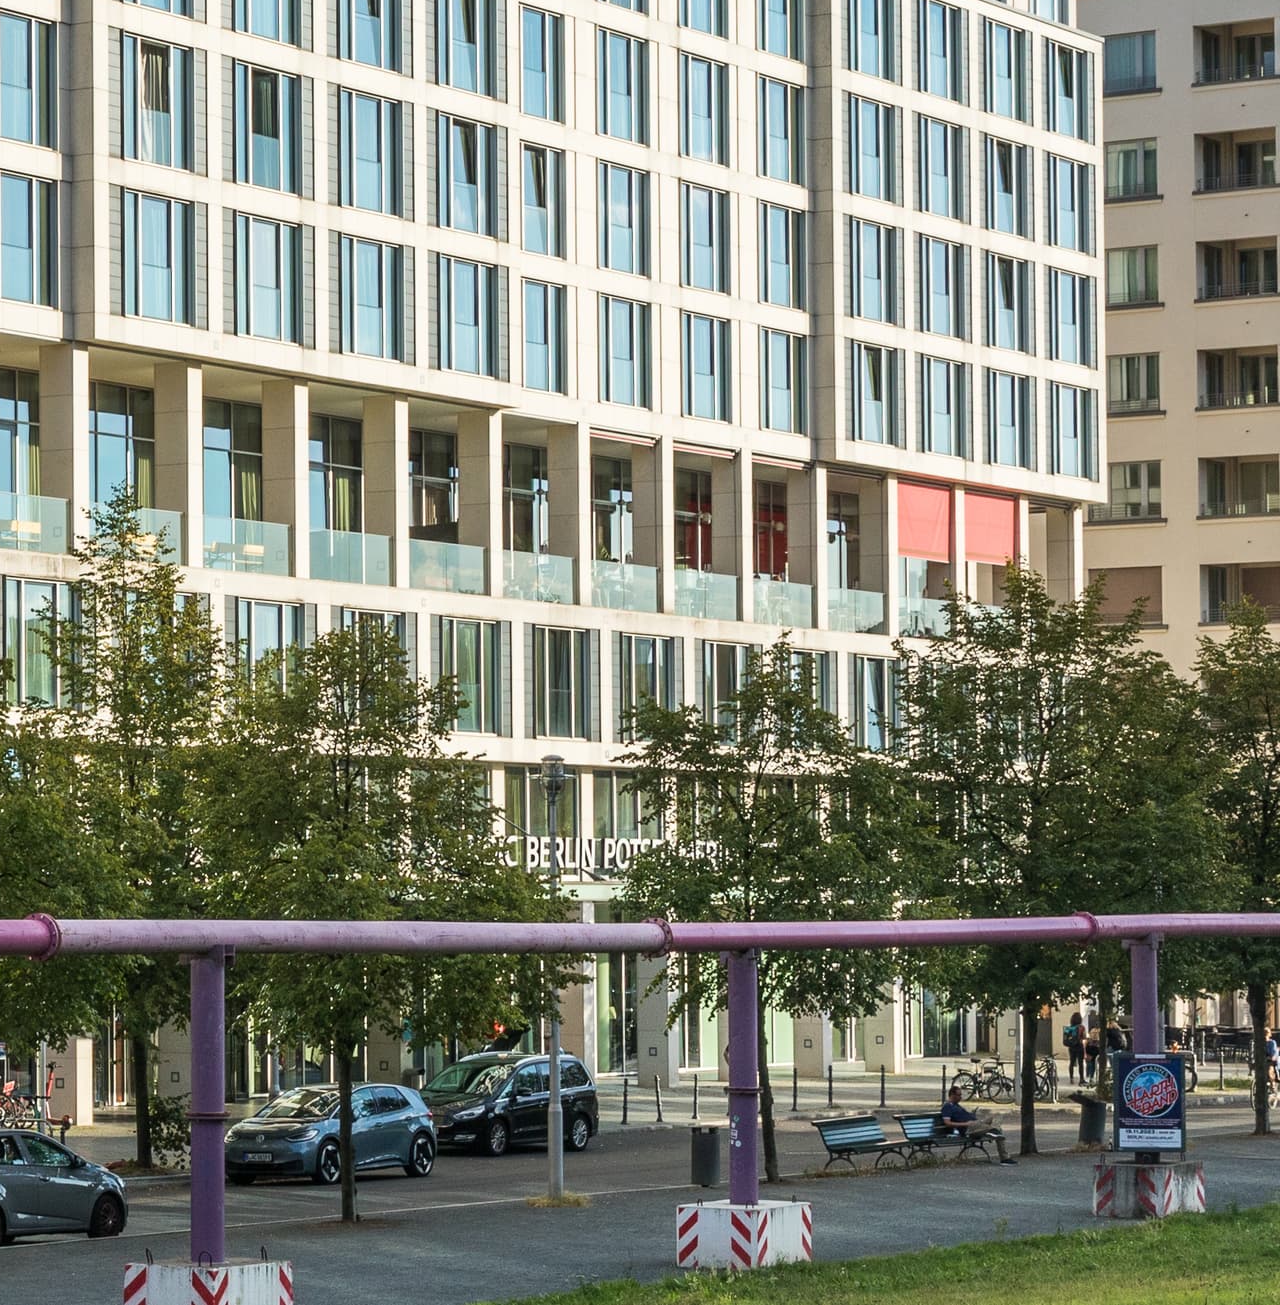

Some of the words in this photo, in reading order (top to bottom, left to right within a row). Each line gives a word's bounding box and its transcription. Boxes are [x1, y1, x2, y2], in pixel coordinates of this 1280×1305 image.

[526, 836, 595, 869] BERLIN
[1127, 1076, 1176, 1109] EARTH
[1141, 1089, 1179, 1116] BAND
